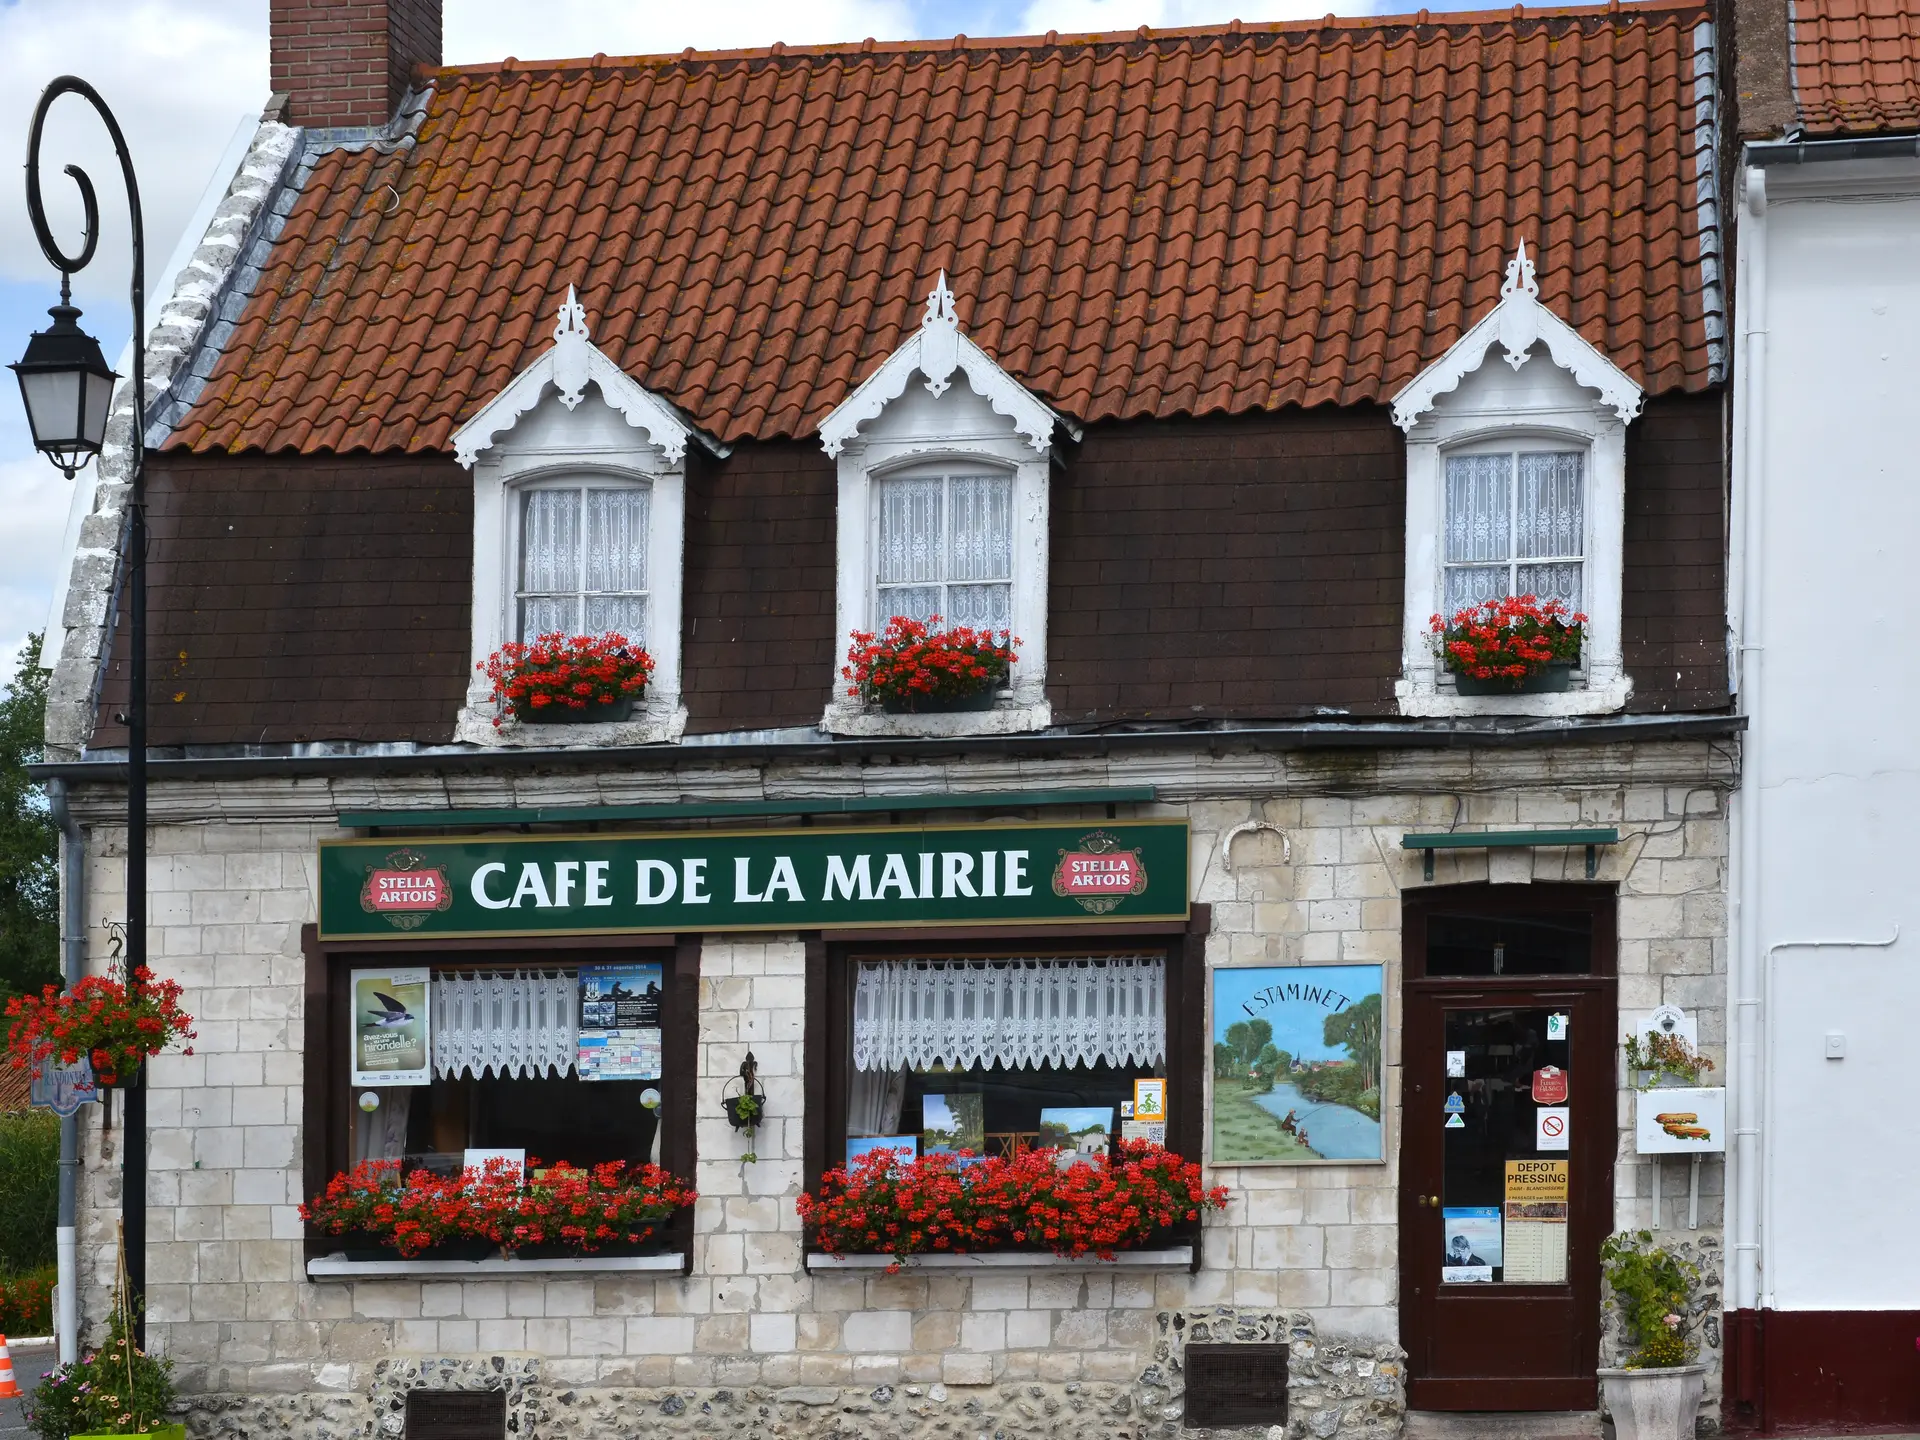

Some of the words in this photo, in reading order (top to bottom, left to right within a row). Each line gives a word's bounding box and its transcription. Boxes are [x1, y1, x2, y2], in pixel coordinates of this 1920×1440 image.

[1071, 860, 1129, 873] STELLA
[379, 877, 435, 889] STELLA
[470, 861, 613, 909] CAFE
[635, 858, 711, 905] DE
[733, 856, 806, 903] LA
[822, 850, 1034, 901] MAIRIE
[1071, 874, 1131, 886] ARTOIS
[379, 890, 436, 902] ARTOIS
[1242, 984, 1350, 1016] ESTAMINET
[363, 1031, 398, 1041] avez-vous
[364, 1034, 417, 1053] hirondelle?
[1448, 1096, 1462, 1107] 62
[1517, 1163, 1556, 1172] DEPOT
[1507, 1173, 1566, 1183] PRESSING
